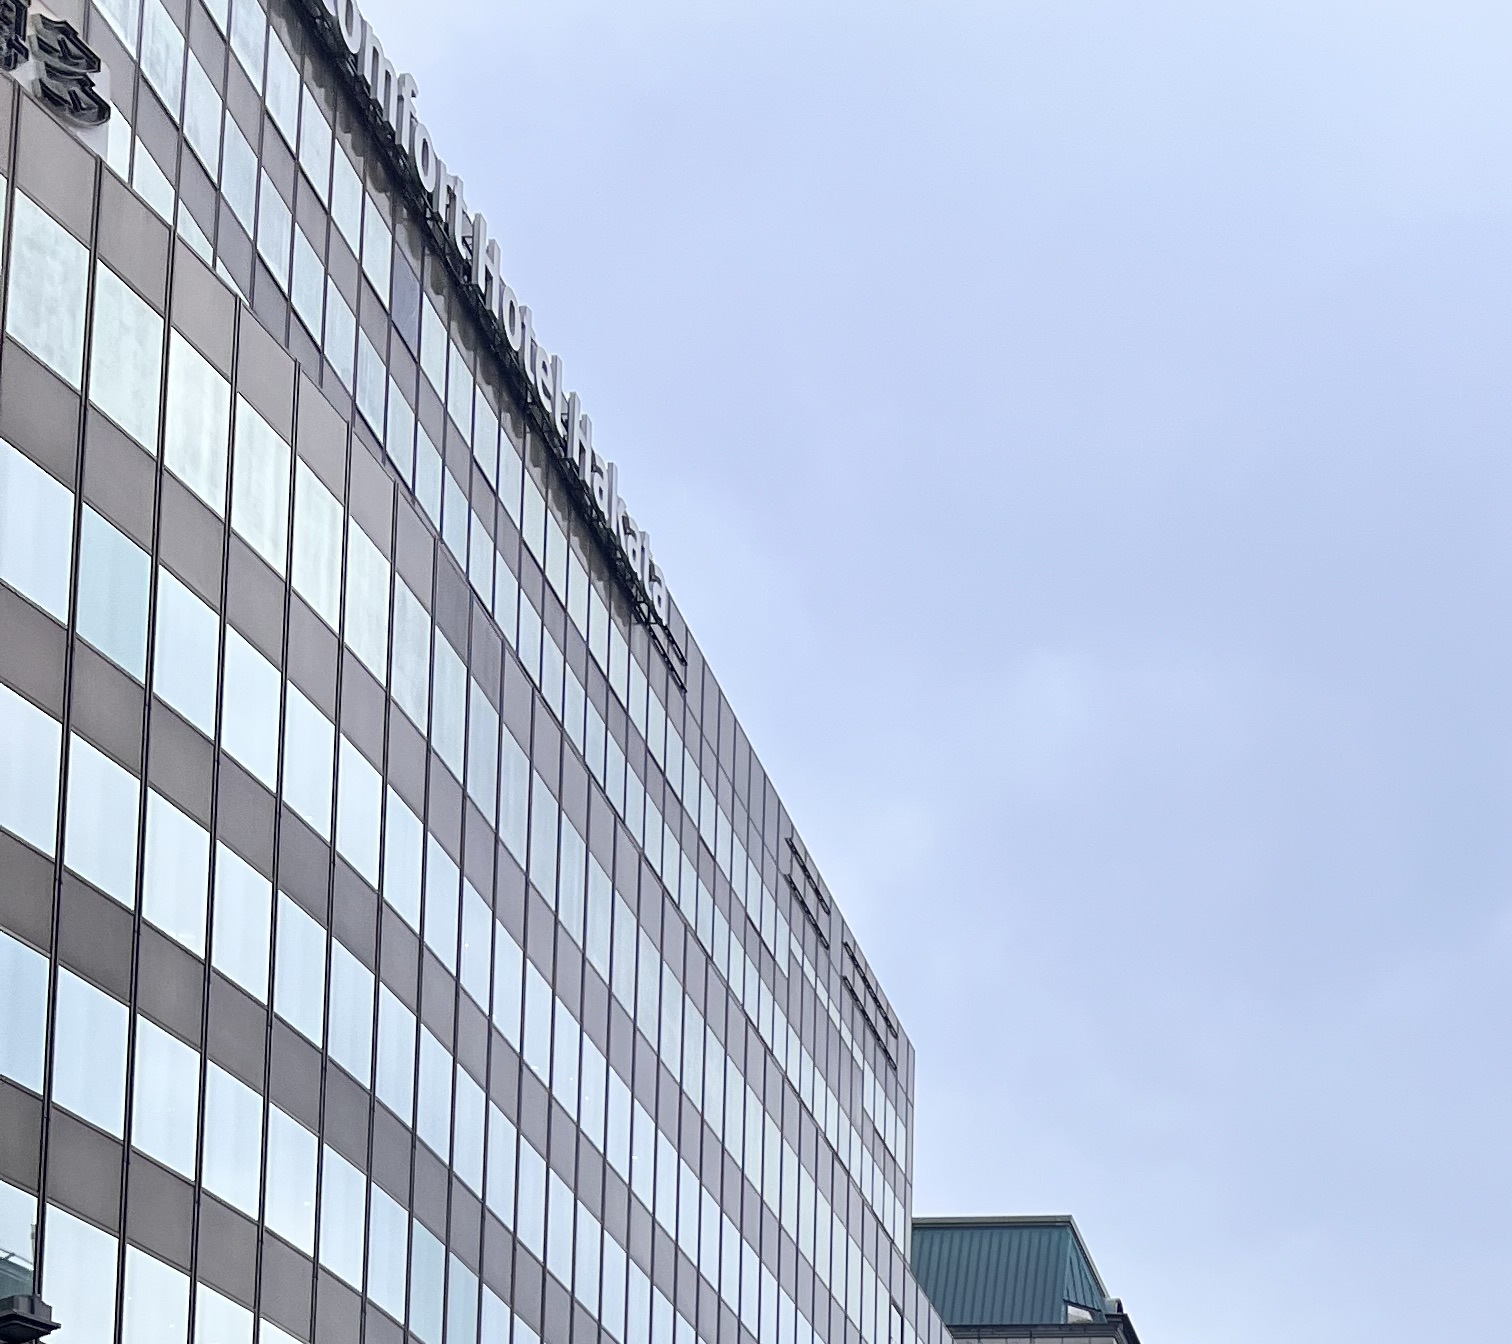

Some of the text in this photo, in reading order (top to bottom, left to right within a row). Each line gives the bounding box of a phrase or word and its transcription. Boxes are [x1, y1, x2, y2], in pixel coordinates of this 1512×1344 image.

[317, 0, 669, 627] omfort Hotel Hakata
